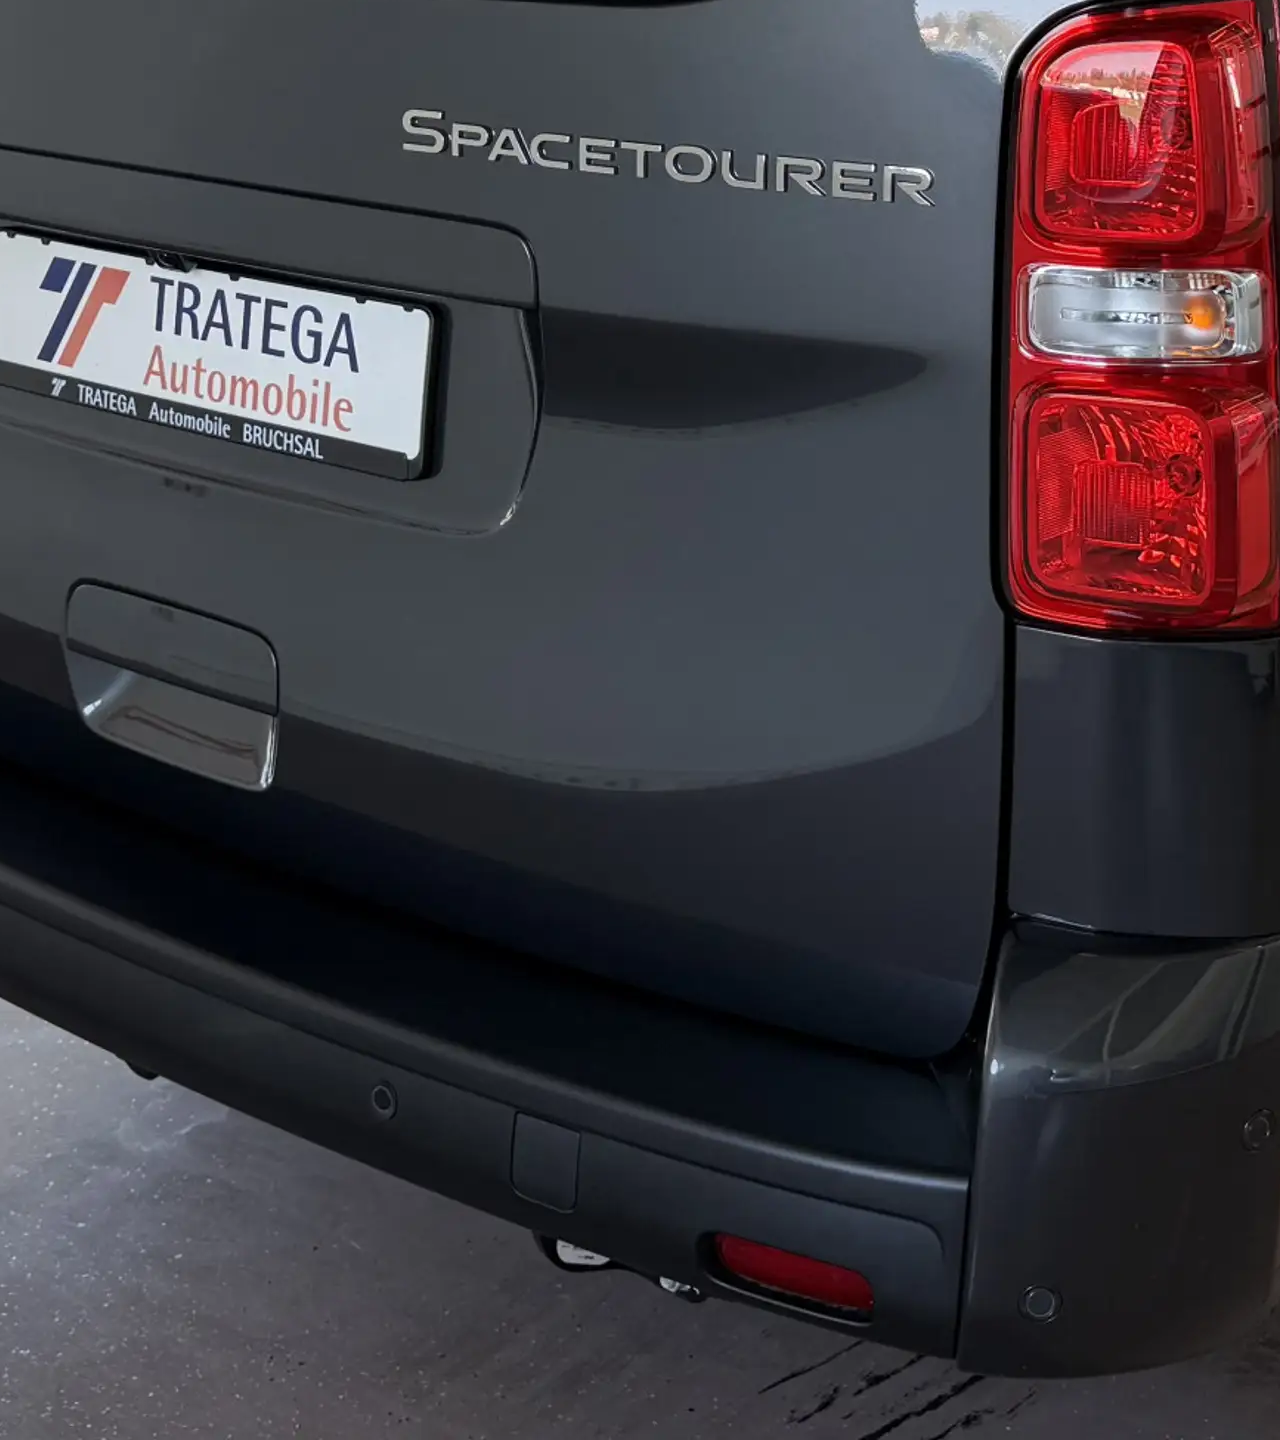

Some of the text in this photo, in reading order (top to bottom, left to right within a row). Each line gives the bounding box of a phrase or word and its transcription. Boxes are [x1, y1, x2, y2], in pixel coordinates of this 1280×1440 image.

[150, 275, 360, 373] TRATEGA
[77, 382, 324, 460] TRATEGA Automobile BRUCHSAL
[143, 344, 355, 433] Automobile
